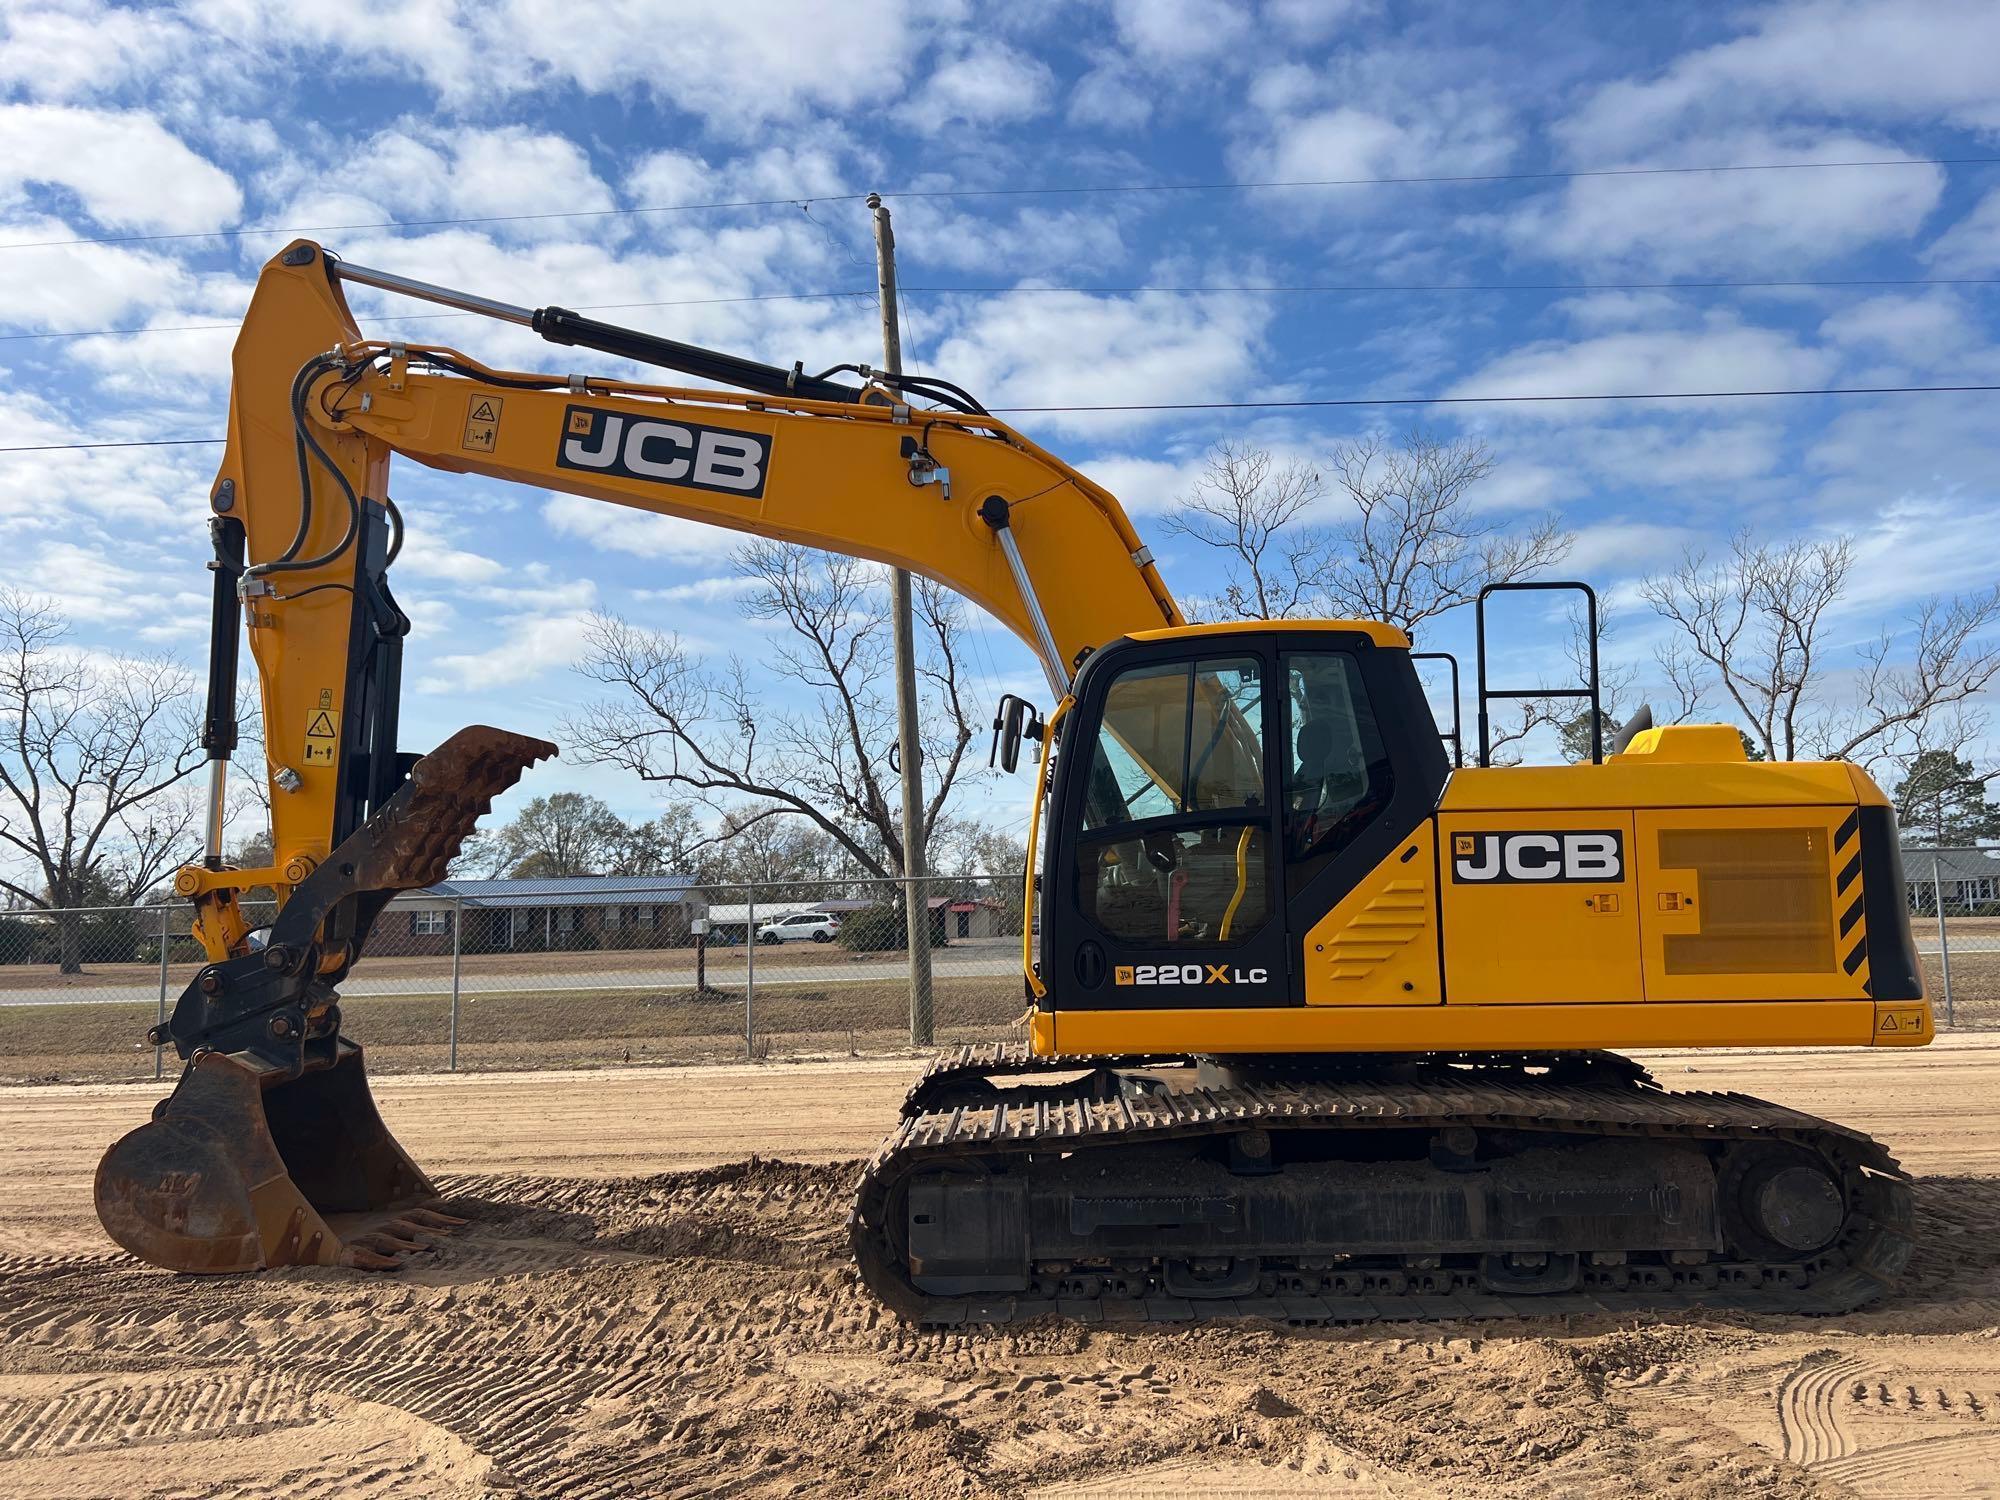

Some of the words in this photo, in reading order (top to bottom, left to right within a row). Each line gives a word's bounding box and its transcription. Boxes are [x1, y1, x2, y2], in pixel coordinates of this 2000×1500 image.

[565, 416, 763, 490] JCB
[1457, 835, 1620, 880] JCB
[1136, 965, 1230, 985] 220X
[1235, 969, 1268, 984] LC
